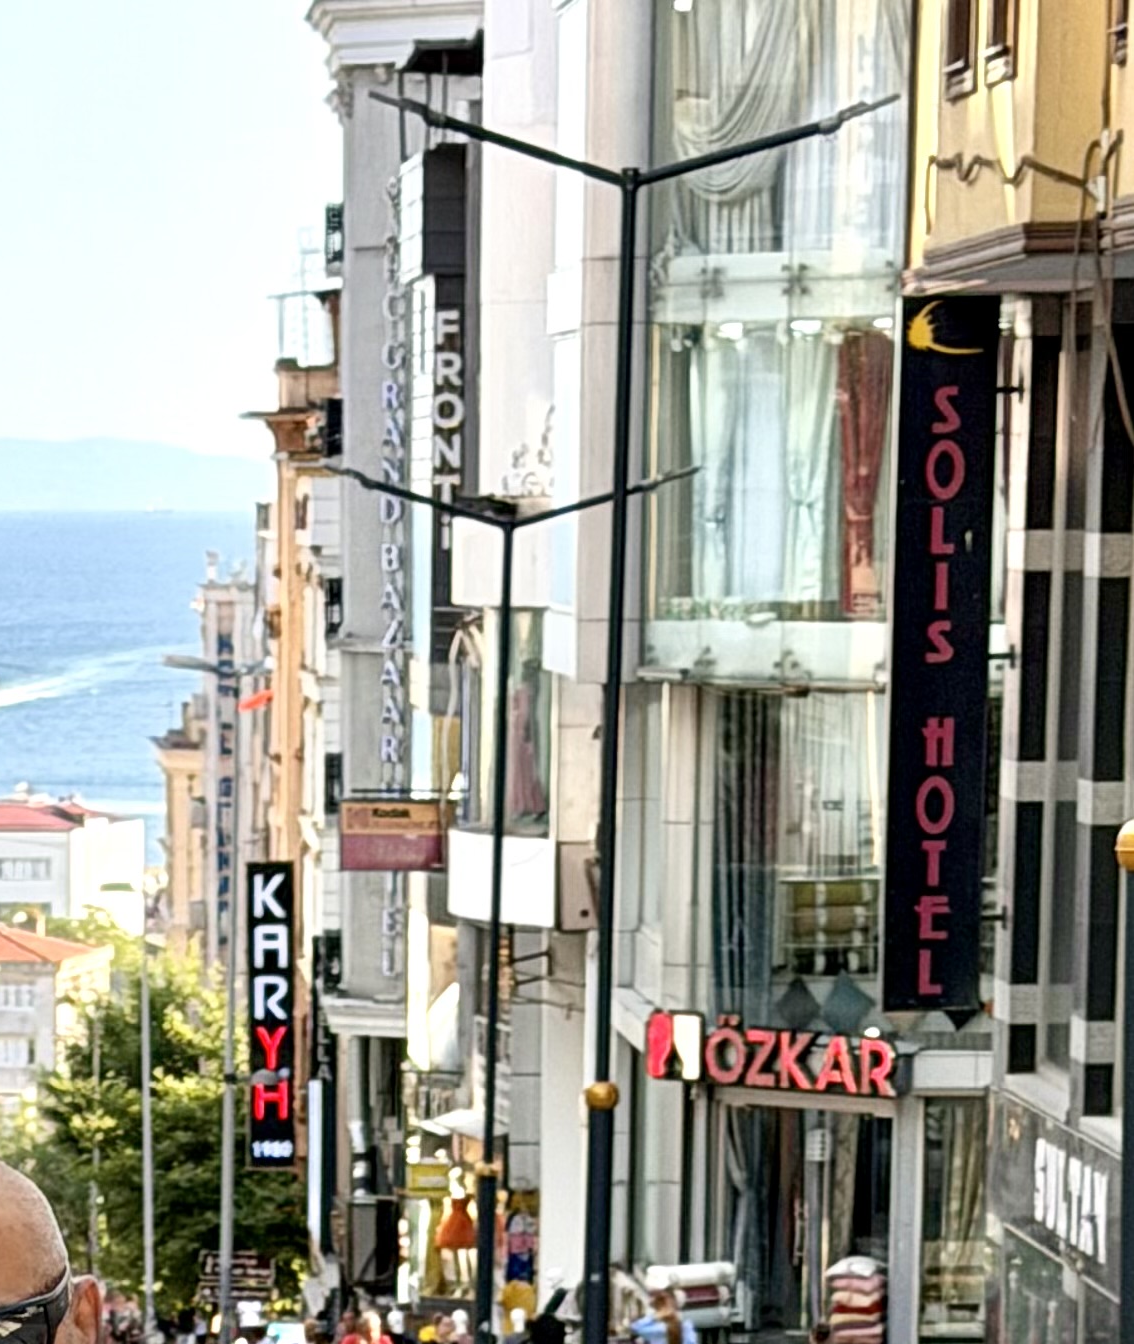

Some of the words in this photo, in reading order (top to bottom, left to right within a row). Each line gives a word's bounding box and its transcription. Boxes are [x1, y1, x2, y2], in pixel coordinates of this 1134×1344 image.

[925, 385, 966, 664] SOLIS
[914, 716, 956, 996] HOTEL
[705, 1013, 897, 1098] ÖZKAR
